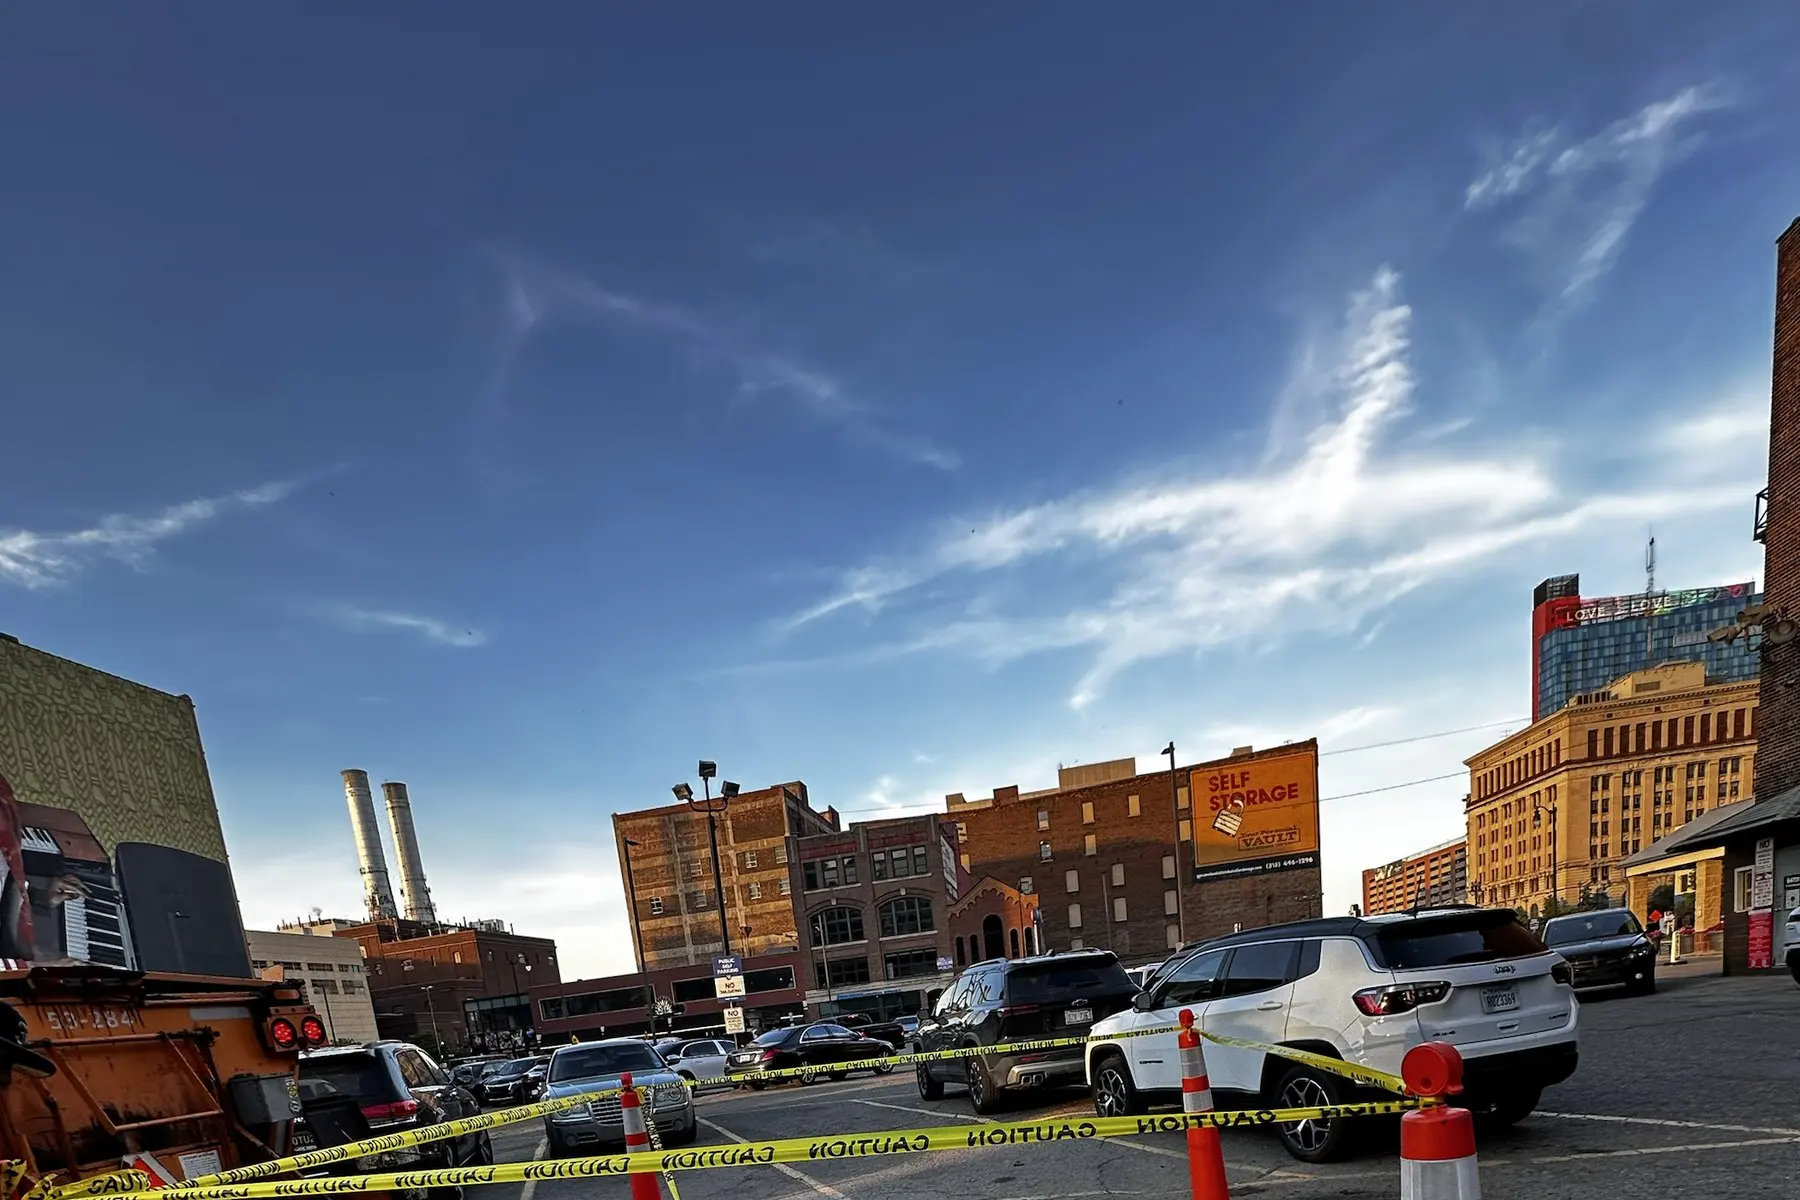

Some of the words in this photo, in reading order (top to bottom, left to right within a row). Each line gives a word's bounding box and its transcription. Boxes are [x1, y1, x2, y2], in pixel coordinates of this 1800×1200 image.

[1566, 606, 1605, 622] LOVE
[1630, 596, 1672, 612] LOVE
[1208, 771, 1250, 792] SELF
[1209, 783, 1299, 811] STORAGE
[1241, 831, 1297, 847] VAULT
[87, 1172, 148, 1194] CAUT
